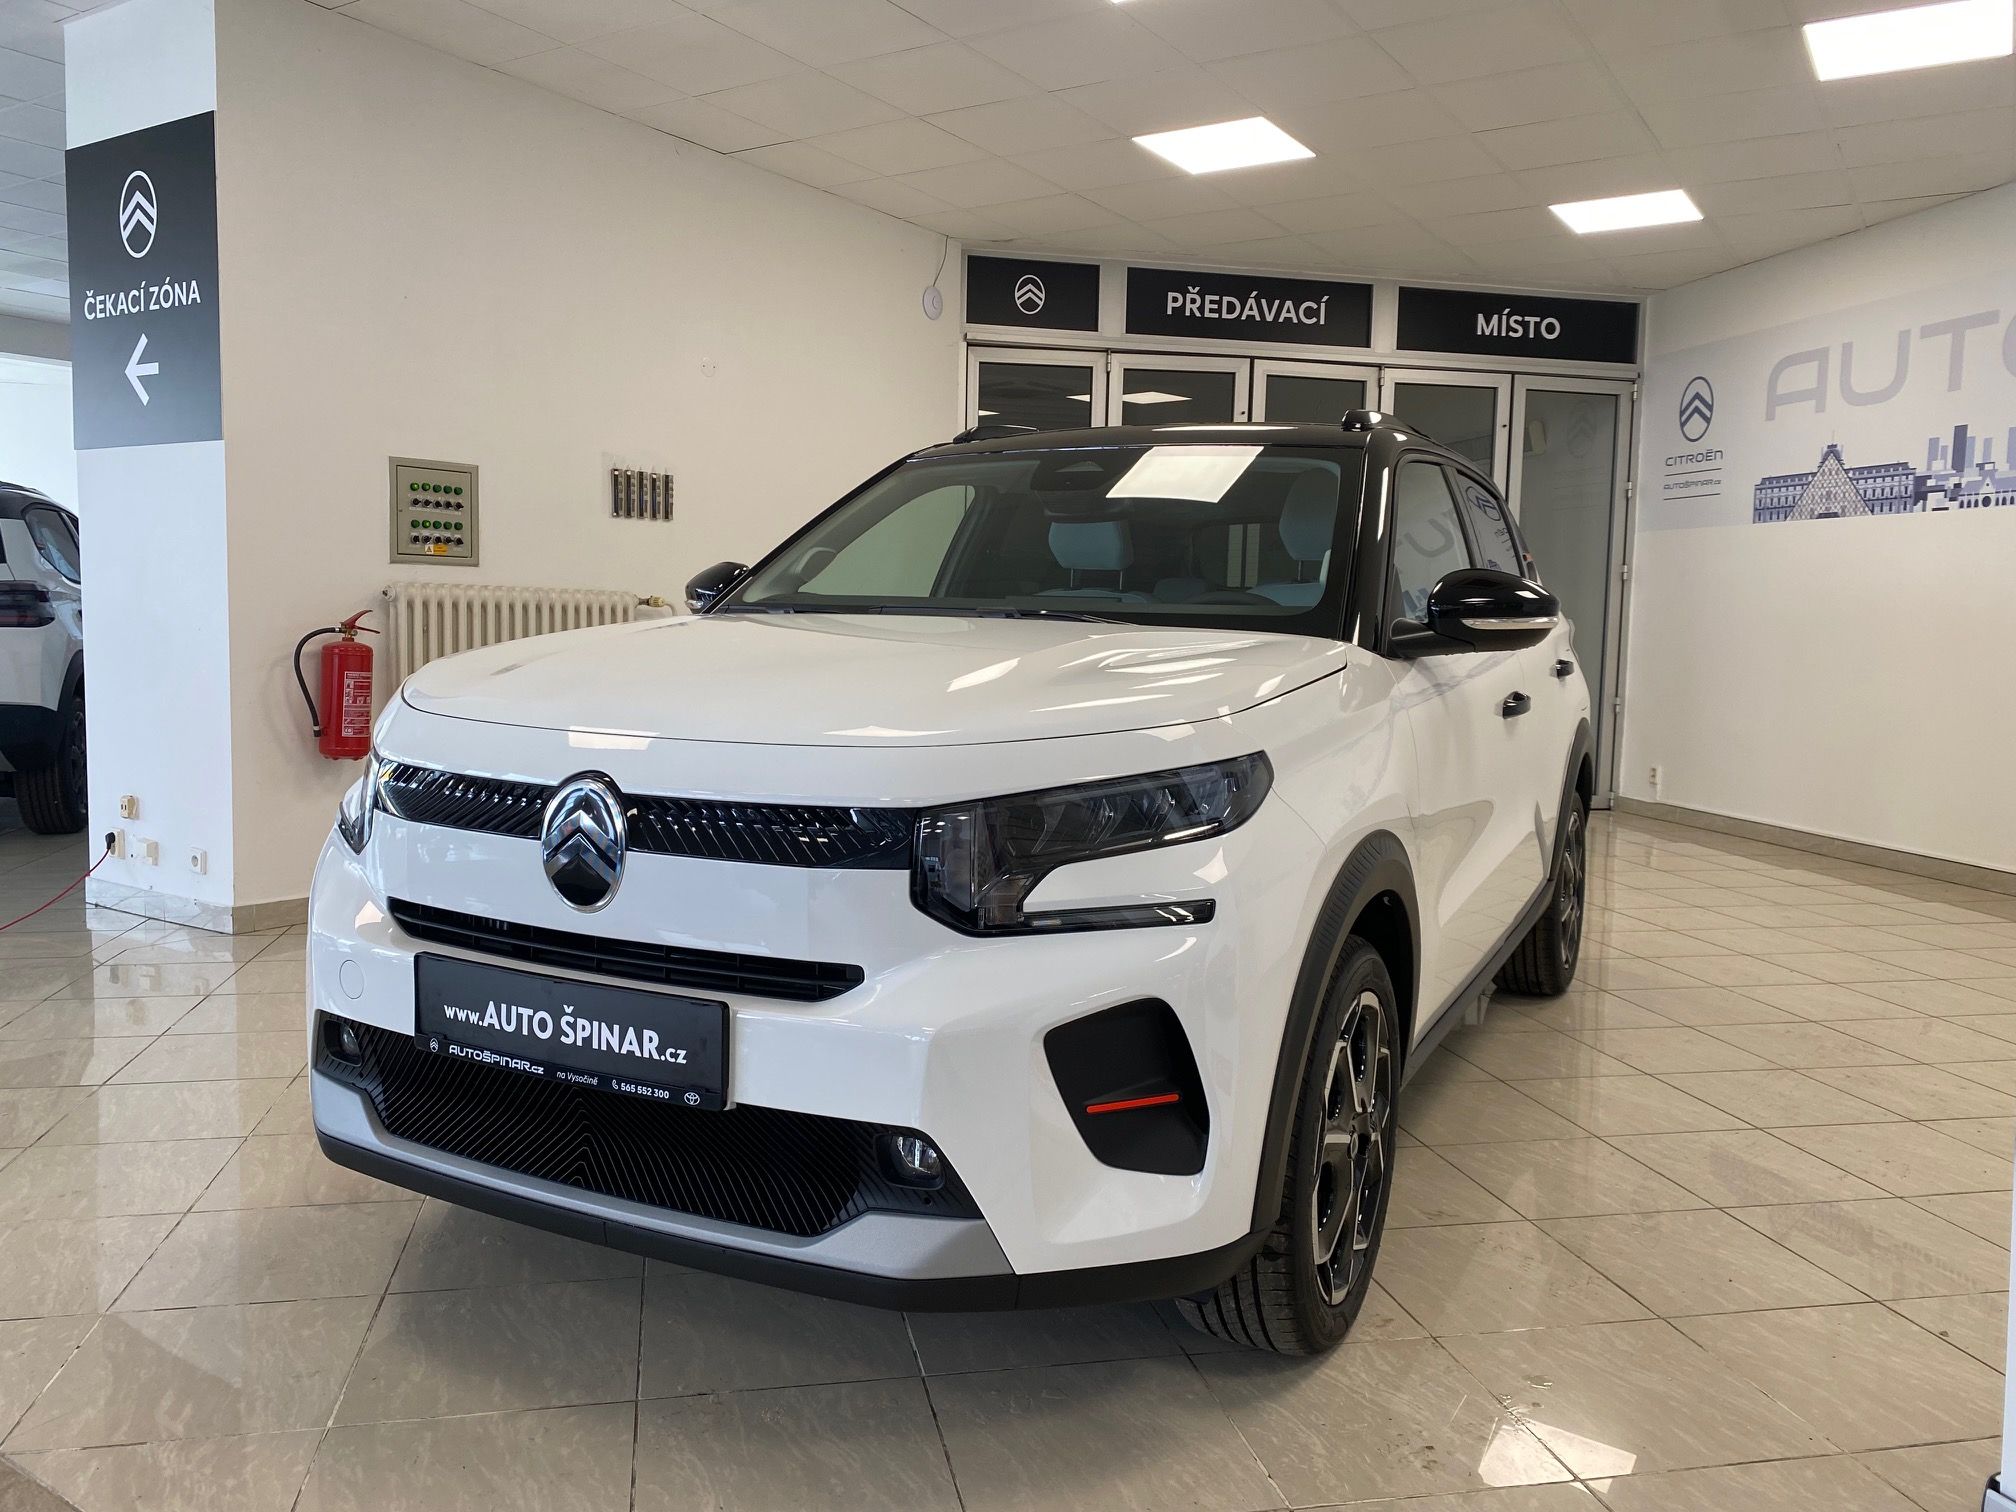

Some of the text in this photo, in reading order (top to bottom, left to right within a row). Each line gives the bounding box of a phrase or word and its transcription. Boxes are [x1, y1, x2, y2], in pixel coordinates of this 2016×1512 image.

[84, 276, 201, 321] ČEKACÍ ZÓNA
[1167, 285, 1561, 340] PŘEDÁVACÍ MÍSTO
[1765, 309, 2016, 421] AUT
[443, 1000, 687, 1065] www.AUTO ŠPINAR.cz
[556, 1071, 566, 1079] na
[567, 1071, 599, 1086] Vysočině
[620, 1081, 636, 1094] 565
[637, 1084, 652, 1096] 552
[653, 1087, 670, 1099] 300
